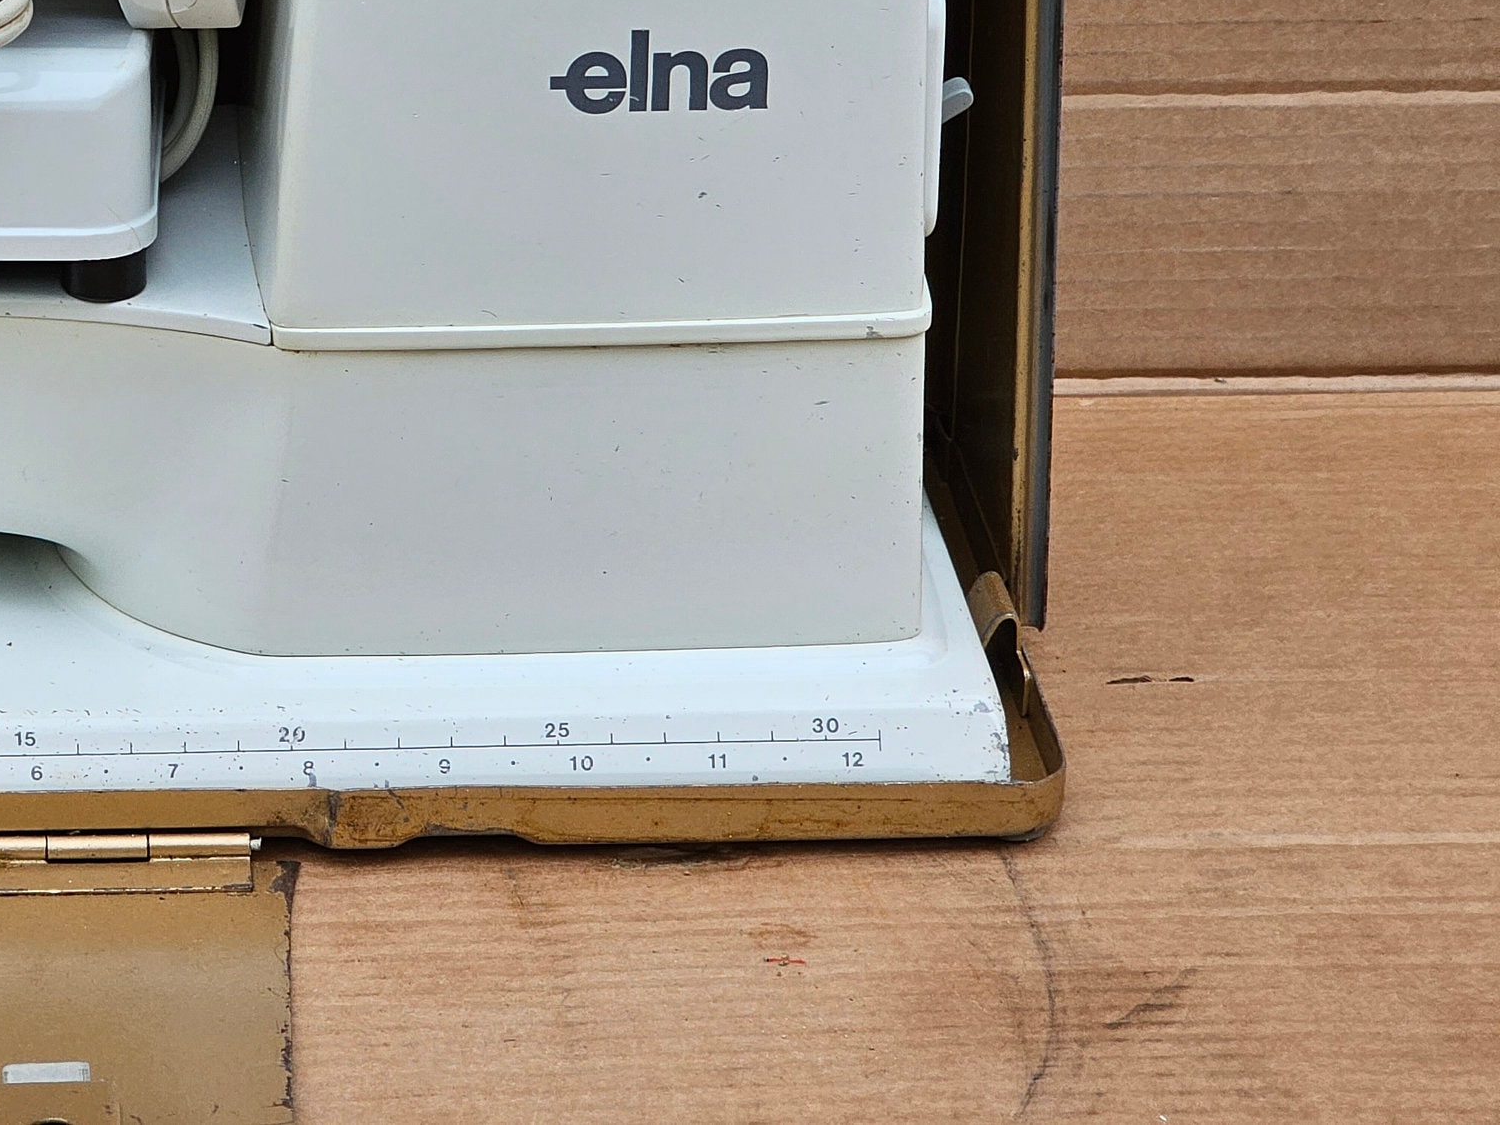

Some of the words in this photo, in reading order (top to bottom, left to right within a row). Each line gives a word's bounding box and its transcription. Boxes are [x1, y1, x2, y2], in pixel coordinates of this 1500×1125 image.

[549, 29, 769, 115] elna
[14, 731, 36, 747] 15
[278, 726, 306, 743] 20
[544, 722, 570, 739] 25
[812, 717, 839, 734] 30
[30, 765, 43, 781] 6
[167, 763, 179, 779] 7
[302, 760, 314, 775] 8
[438, 758, 451, 775] 9
[569, 755, 594, 772] 10
[707, 753, 727, 769] 11
[841, 751, 864, 768] 12
